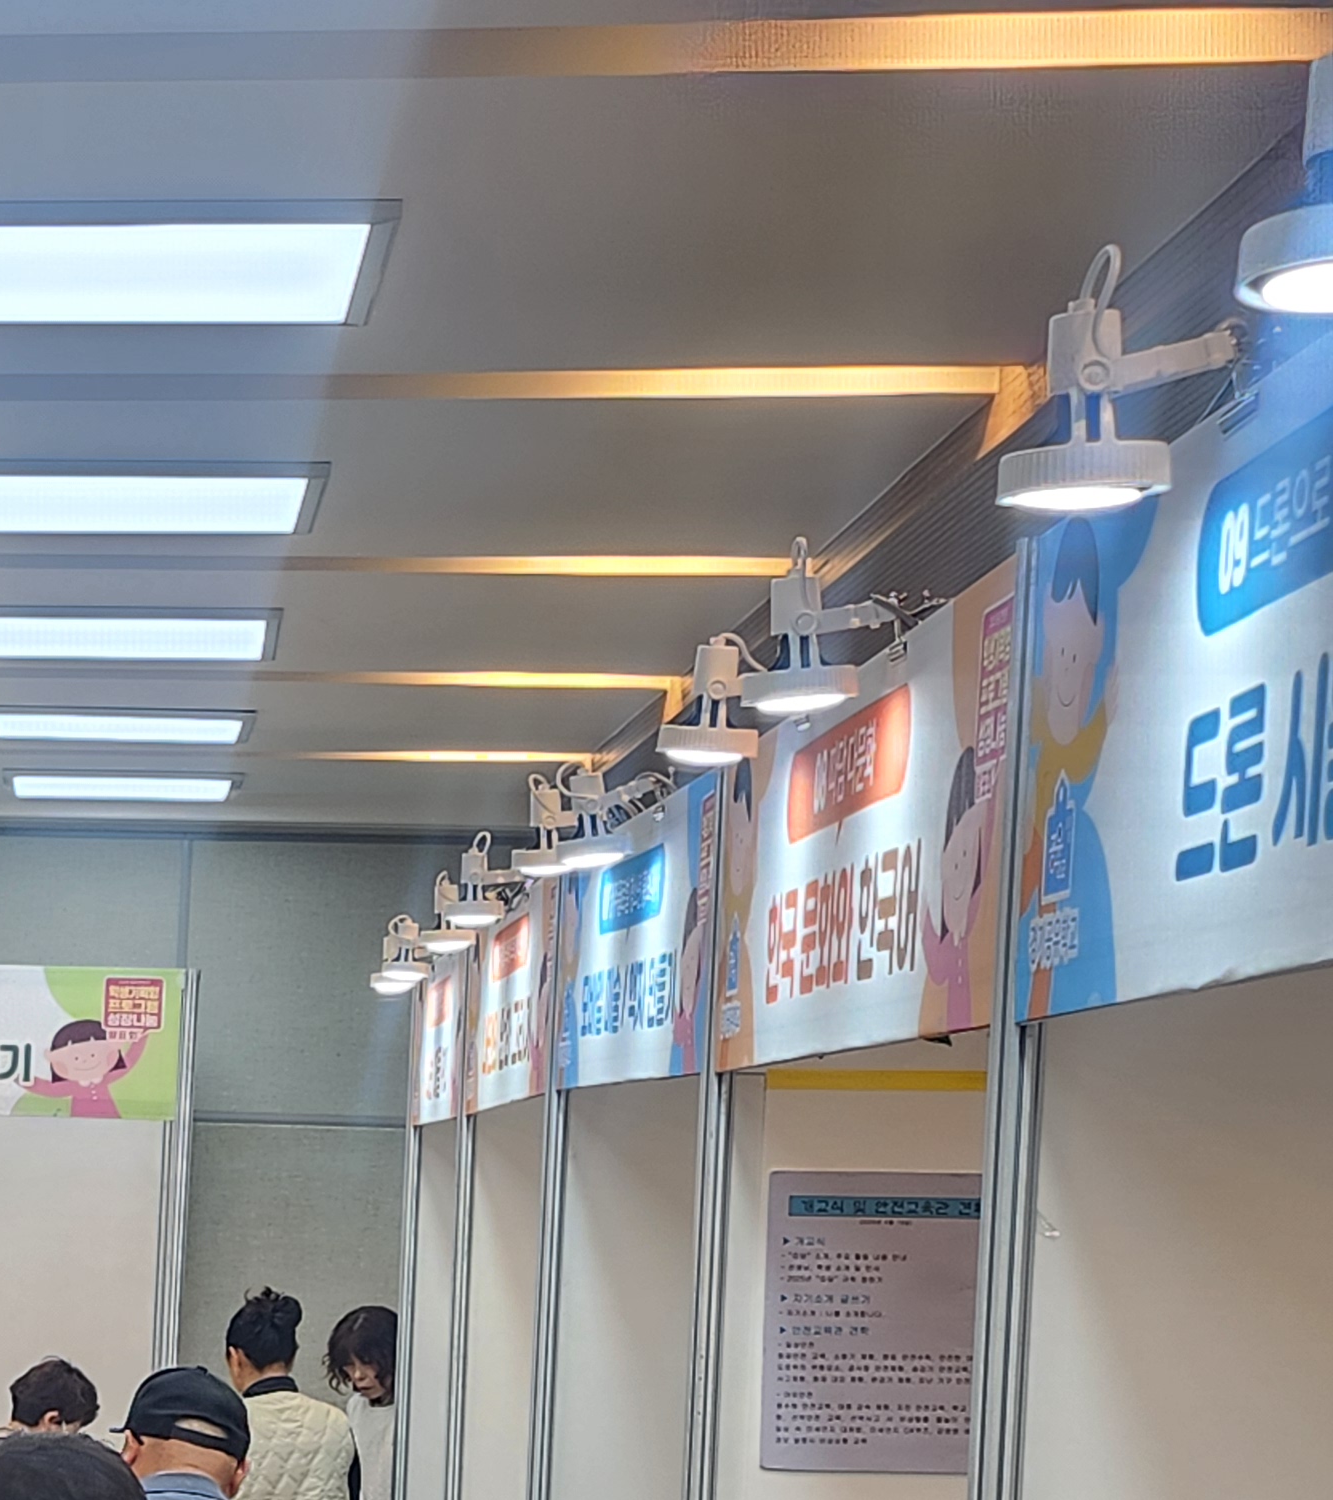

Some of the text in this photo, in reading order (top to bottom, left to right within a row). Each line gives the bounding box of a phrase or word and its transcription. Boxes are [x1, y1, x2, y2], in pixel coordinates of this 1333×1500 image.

[1218, 453, 1332, 595] 09 드론으로
[1175, 651, 1333, 881] 드론 시
[765, 888, 799, 1005] 한국
[800, 862, 855, 995] 문화와
[857, 837, 922, 982] 한국어
